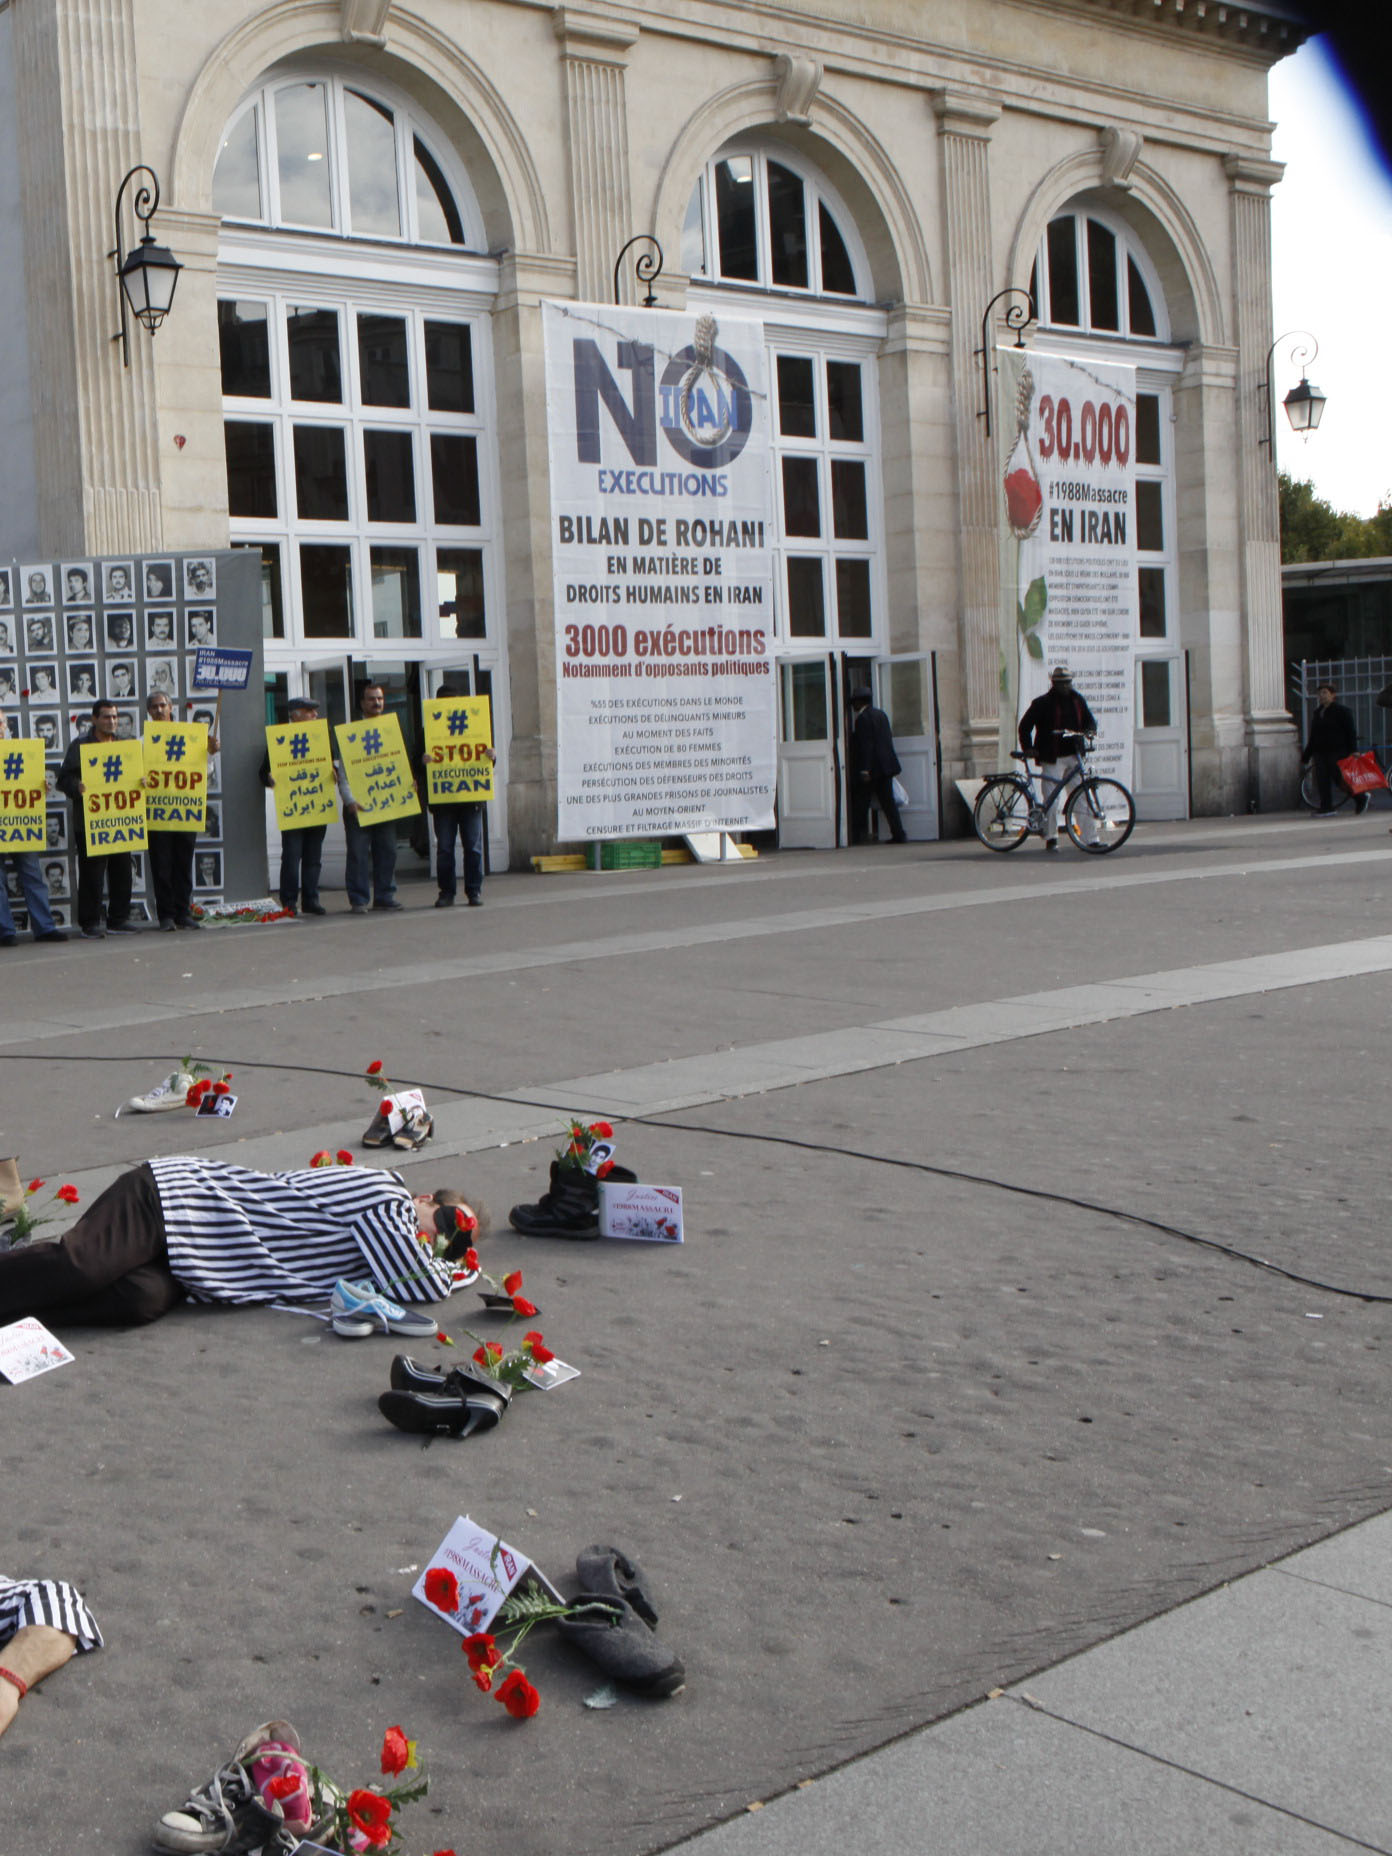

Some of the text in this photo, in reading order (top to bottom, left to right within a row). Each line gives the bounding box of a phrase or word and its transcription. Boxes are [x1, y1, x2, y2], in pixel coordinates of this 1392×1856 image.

[573, 338, 752, 469] NO
[659, 385, 738, 430] IRAN
[1039, 395, 1129, 469] 30.000
[598, 470, 728, 496] EXECUTIONS
[1049, 481, 1127, 503] #1988Massacre
[559, 515, 764, 548] BILAN DE ROHANI
[1050, 508, 1126, 544] EN IRAN
[607, 551, 721, 575] EN MATIÈRE DE
[566, 584, 762, 603] DROITS HUMAINS EN IRAN
[565, 623, 765, 656] 3000 exécutions
[562, 660, 769, 678] Notamment d'opposants politiques
[608, 699, 624, 707] DES
[626, 697, 677, 707] EXÉCUTIONS
[680, 697, 701, 705] DANS
[703, 697, 712, 705] LE
[714, 696, 743, 705] MONDE
[446, 709, 468, 736] #
[588, 714, 638, 724] EXÉCUTIONS
[640, 714, 652, 722] DE
[712, 712, 745, 720] MINEURS
[361, 728, 383, 756] #
[636, 729, 672, 738] MOMENT
[675, 729, 690, 737] DES
[693, 728, 713, 736] FAITS
[165, 734, 185, 762] #
[290, 733, 310, 761] #
[431, 743, 488, 763] STOP
[614, 744, 661, 754] EXÉCUTION
[689, 743, 721, 751] FEMMES
[3, 752, 24, 780] #
[103, 755, 123, 783] #
[365, 761, 395, 777] توقف
[432, 767, 489, 779] EXECUTIONS
[583, 756, 751, 772] EXÉCUTIONS DES MEMBRES DES MINORITÉS
[146, 769, 202, 790] STOP
[289, 768, 319, 782] توقف
[581, 772, 752, 787] PERSÉCUTION DES DÉFENSEURS DES DROITS
[289, 783, 323, 801] اعدام
[367, 775, 401, 796] اعدام
[433, 778, 490, 794] IRAN
[566, 785, 768, 804] UNE DES PLUS GRANDES PRISONS DE JOURNALISTES
[88, 787, 142, 813] STOP
[146, 796, 202, 806] EXECUTIONS
[400, 791, 413, 804] در
[146, 808, 202, 821] IRAN
[283, 799, 333, 817] در ایران
[632, 804, 705, 816] AU MOYEN-ORIENT
[90, 814, 143, 829] EXECUTIONS
[586, 816, 748, 834] CENSURE ET FILTRAGE MASSIF D'INTERNET
[90, 826, 144, 846] IRAN
